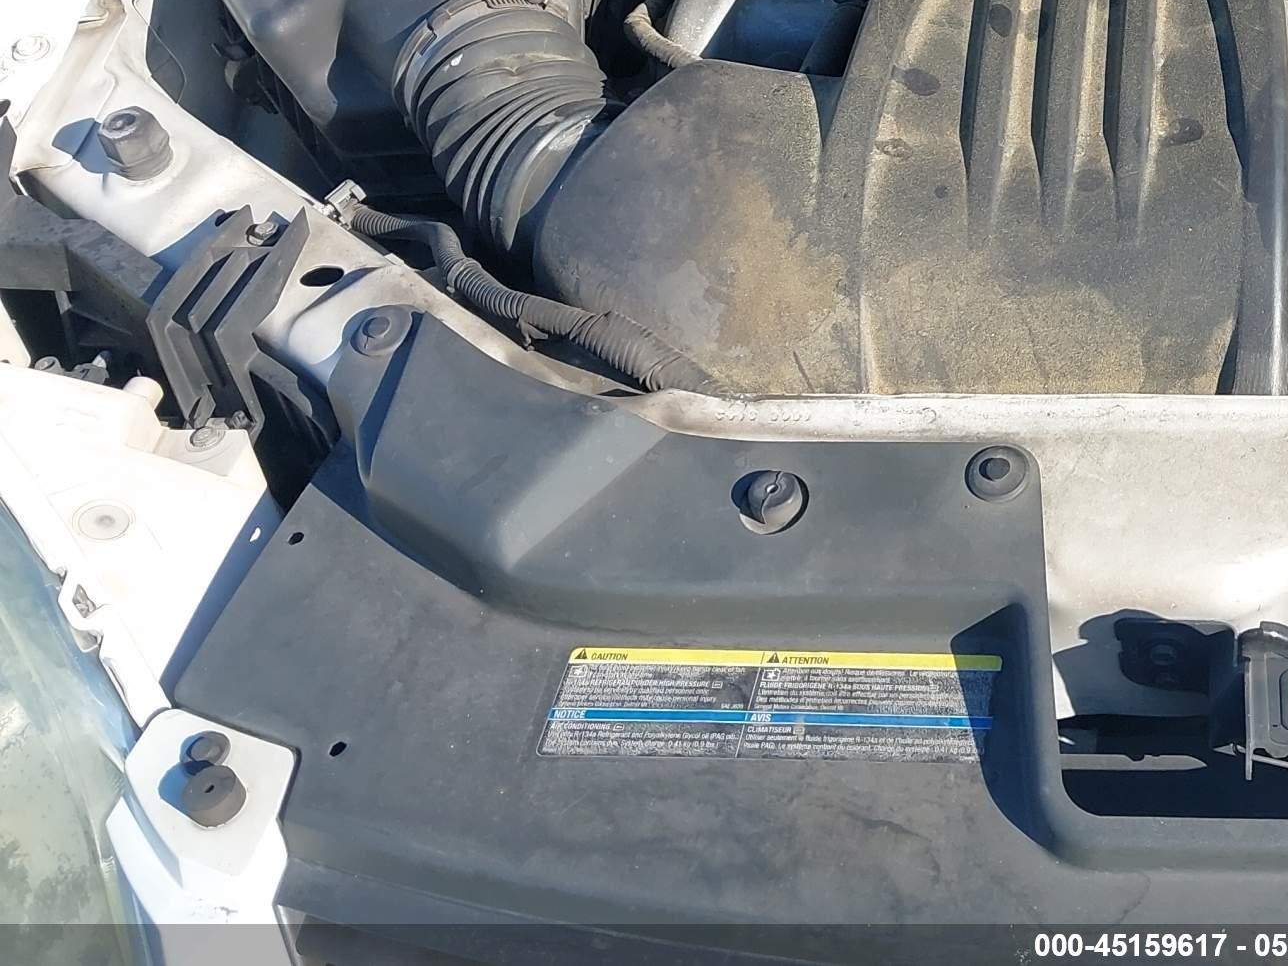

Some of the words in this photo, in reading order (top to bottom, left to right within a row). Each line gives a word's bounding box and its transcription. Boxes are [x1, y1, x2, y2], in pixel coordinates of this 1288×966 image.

[591, 652, 628, 661] CAUTION
[781, 656, 830, 665] ATTENTION
[552, 709, 587, 718] NOTICE
[749, 713, 772, 721] AVIS
[564, 722, 612, 730] CONDITIONING
[746, 725, 793, 733] CLIMATISEUR
